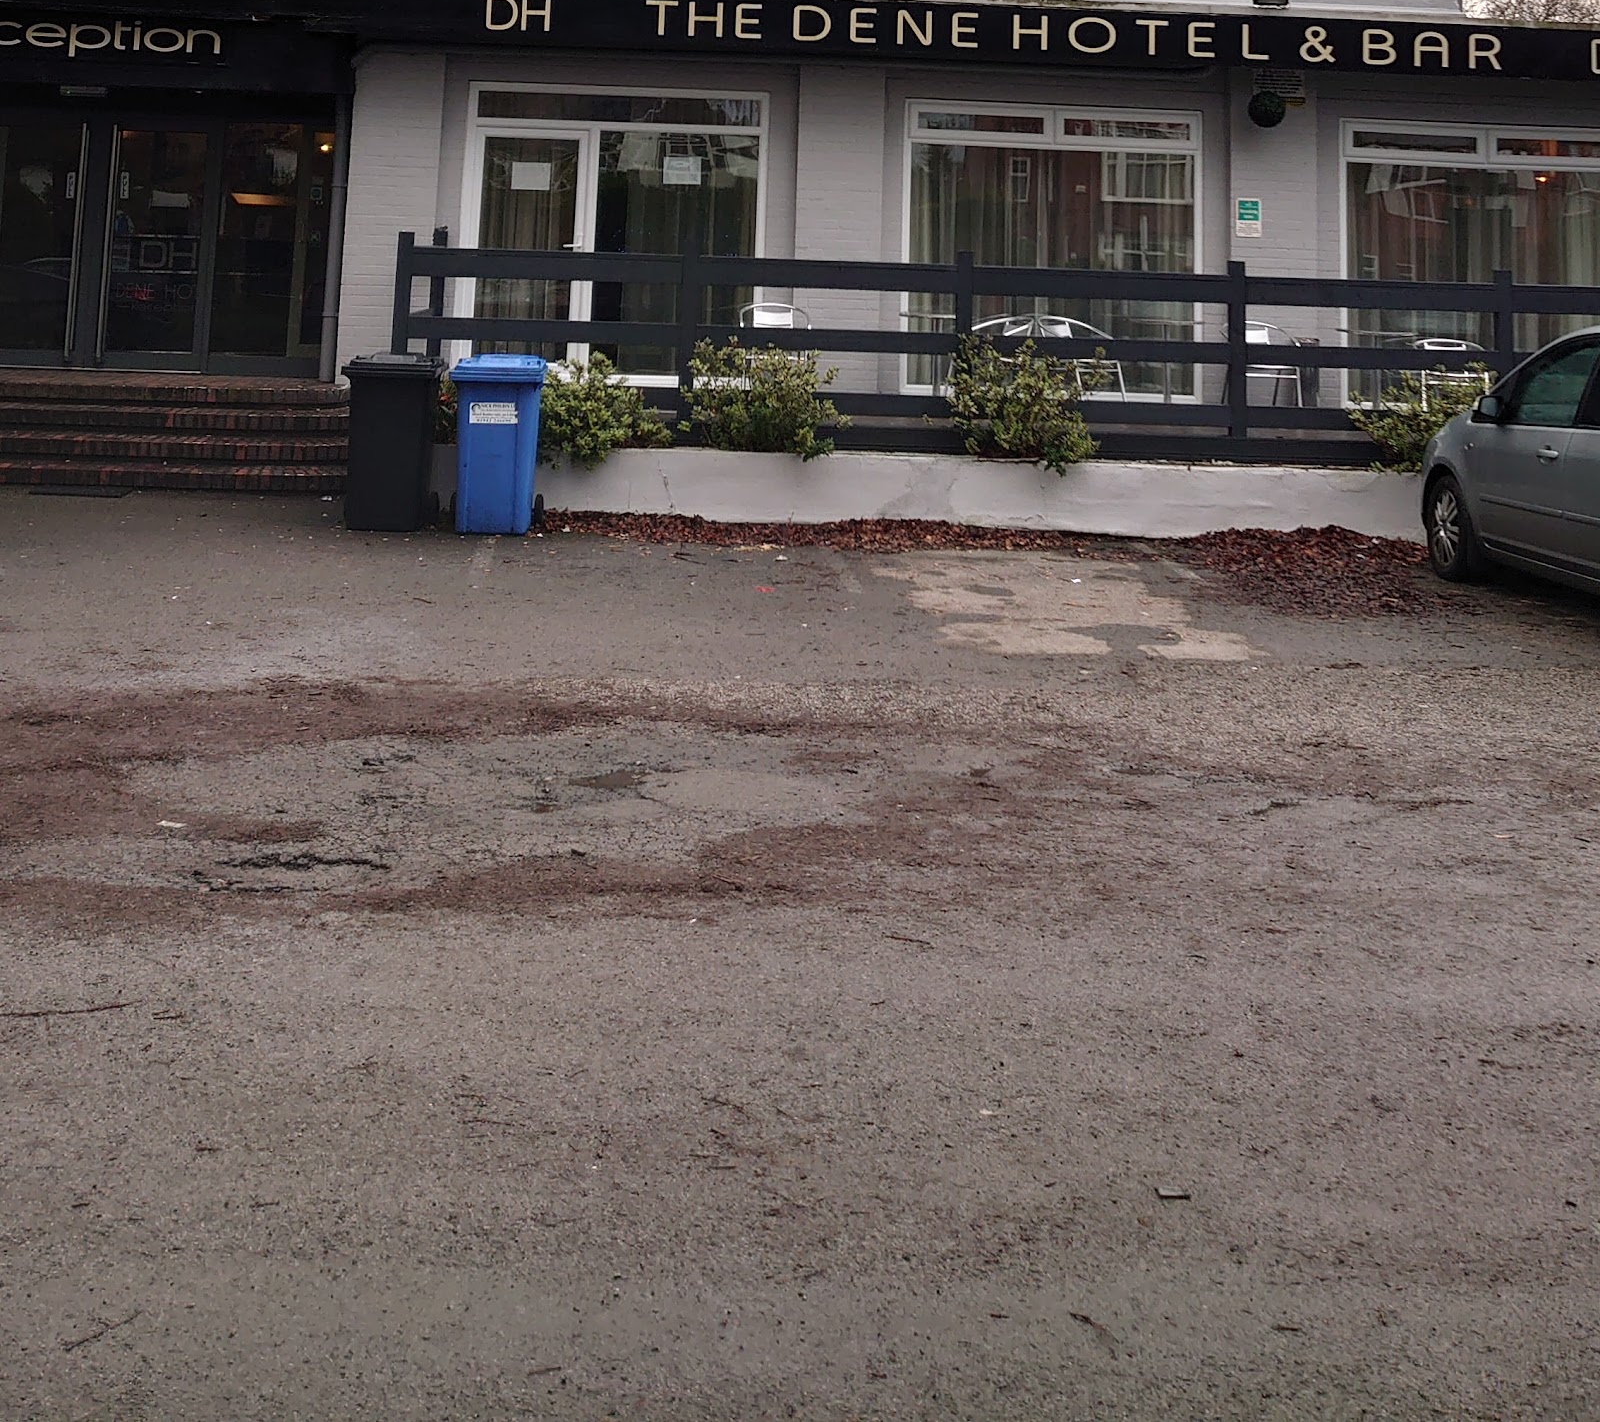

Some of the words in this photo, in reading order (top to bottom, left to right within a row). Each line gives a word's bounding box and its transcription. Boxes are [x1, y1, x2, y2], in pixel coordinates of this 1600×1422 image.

[0, 20, 221, 58] ception
[645, 0, 763, 40] THE
[792, 4, 979, 49] DENE
[1012, 14, 1270, 60] HOTEL
[1299, 25, 1337, 63] &
[1362, 28, 1503, 70] BAR
[139, 240, 198, 269] DH
